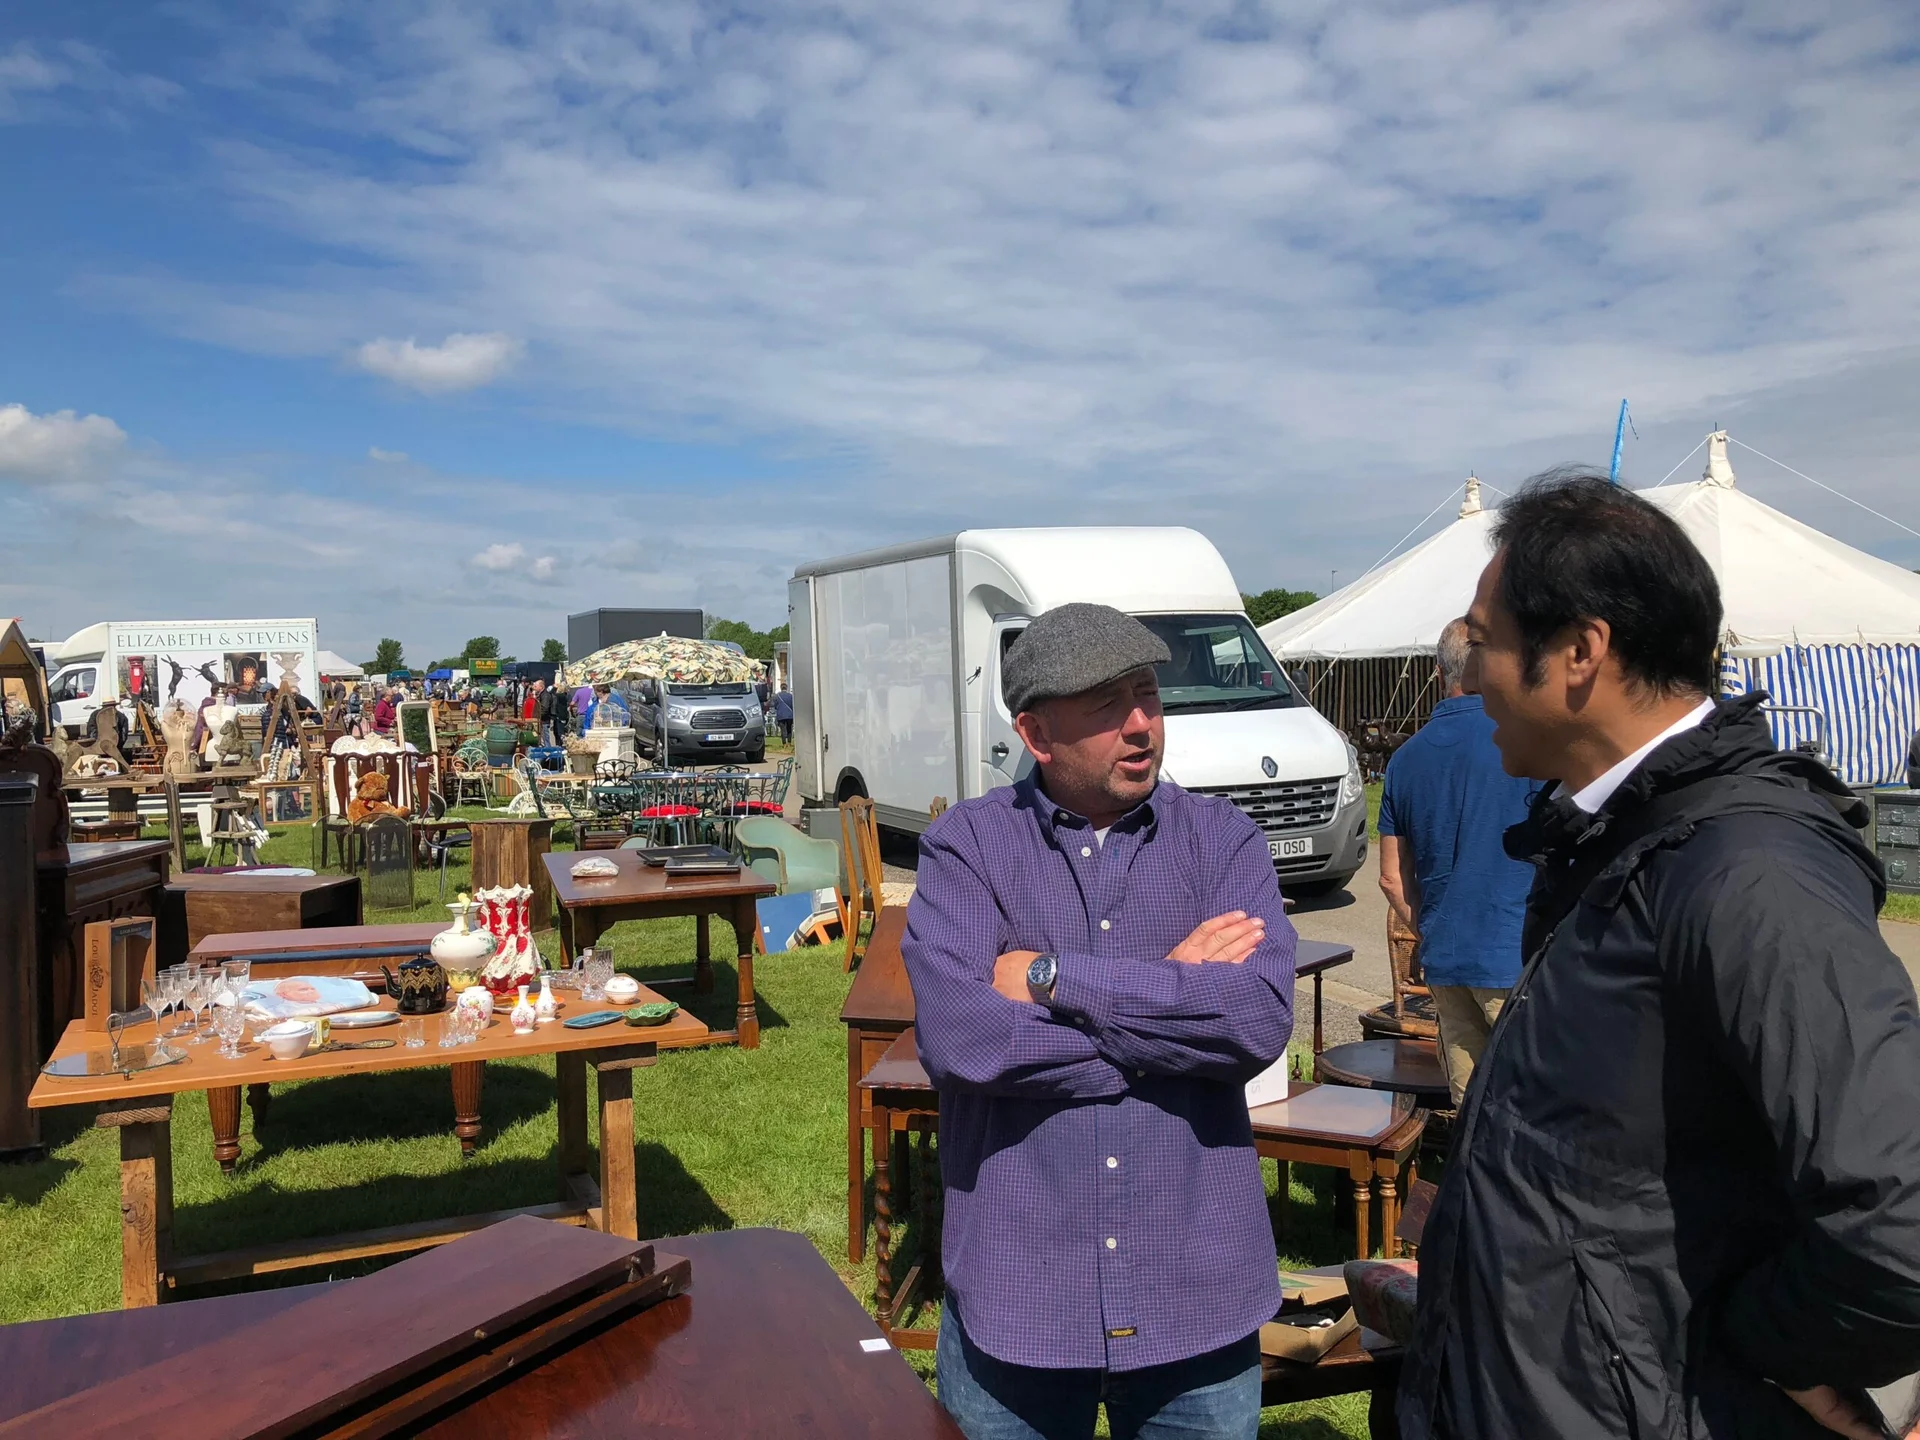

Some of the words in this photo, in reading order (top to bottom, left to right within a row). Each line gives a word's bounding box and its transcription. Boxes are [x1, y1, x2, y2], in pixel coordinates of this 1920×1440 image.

[117, 633, 212, 648] ELIZABETH
[218, 632, 231, 645] &
[236, 631, 309, 645] STEVENS
[1269, 843, 1281, 856] 61
[1284, 840, 1306, 855] OSO
[1249, 1077, 1265, 1094] is
